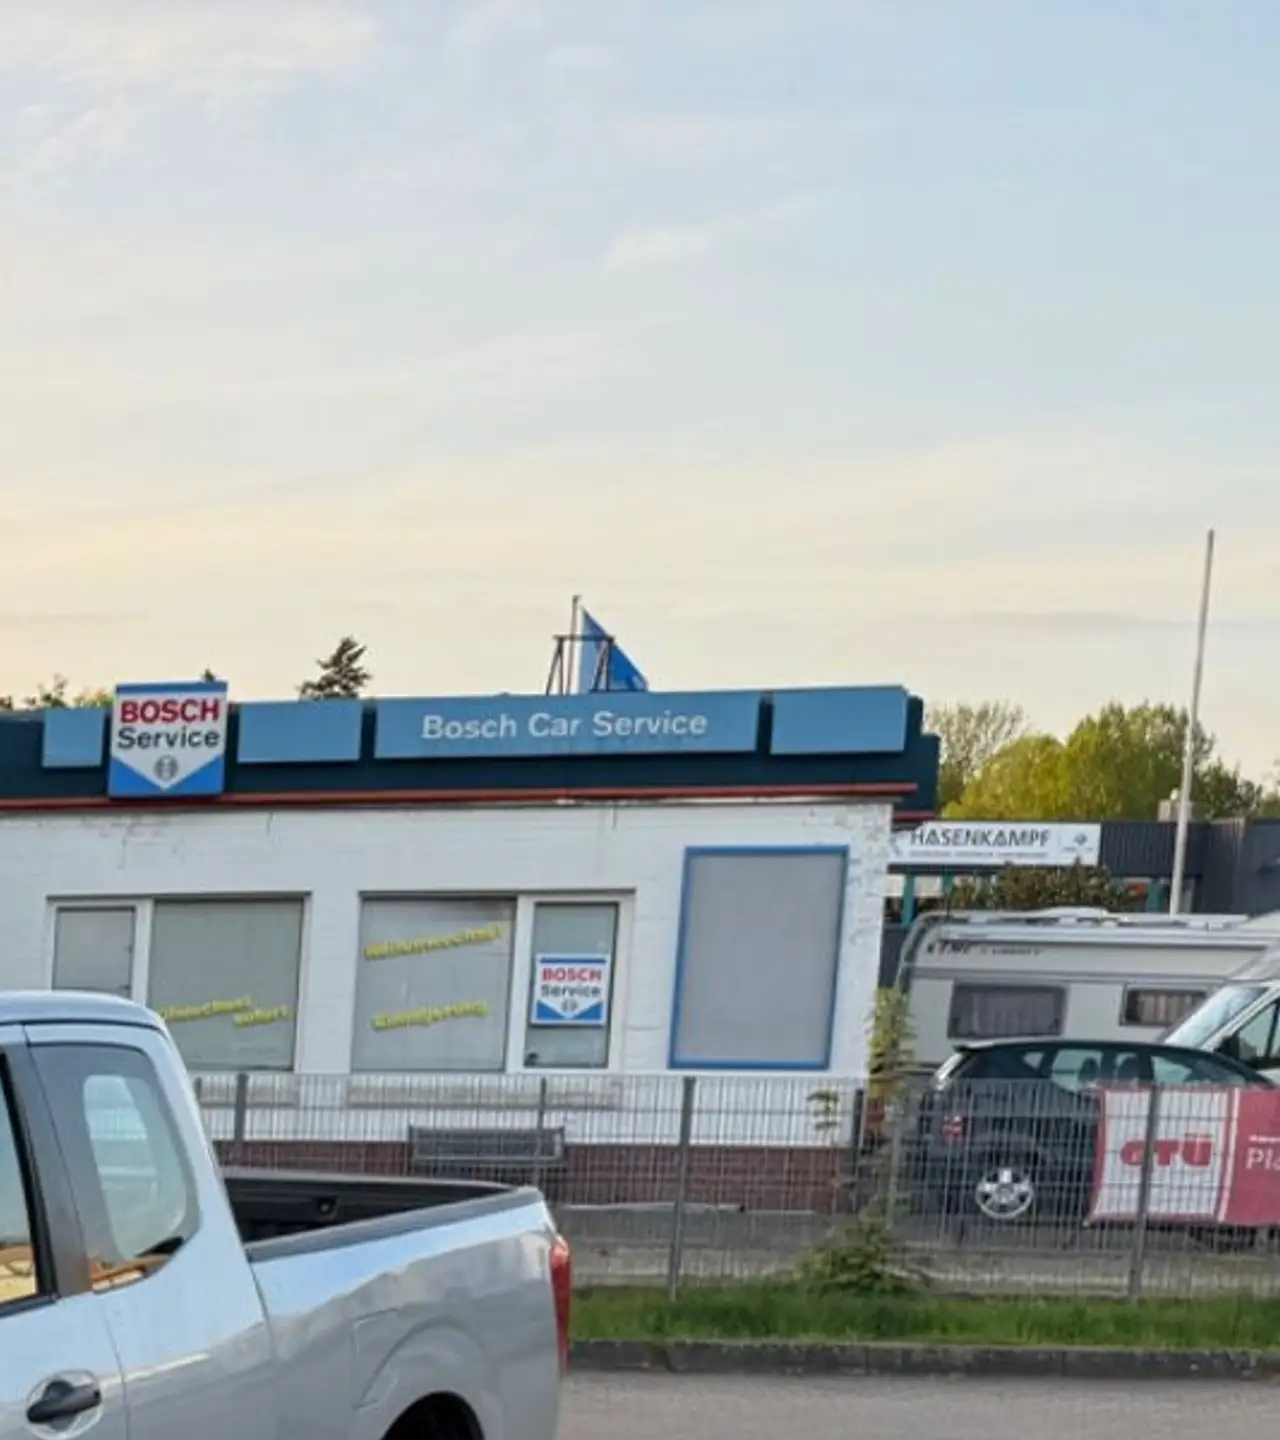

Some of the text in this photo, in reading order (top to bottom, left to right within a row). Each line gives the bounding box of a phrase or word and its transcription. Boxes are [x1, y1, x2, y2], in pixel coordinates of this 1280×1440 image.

[121, 698, 219, 724] BOSCH
[421, 709, 709, 739] Bosch Car Service
[118, 725, 220, 750] Service
[909, 828, 1050, 847] HASENKAMPF
[542, 967, 602, 982] BOSCH
[541, 983, 601, 998] Service
